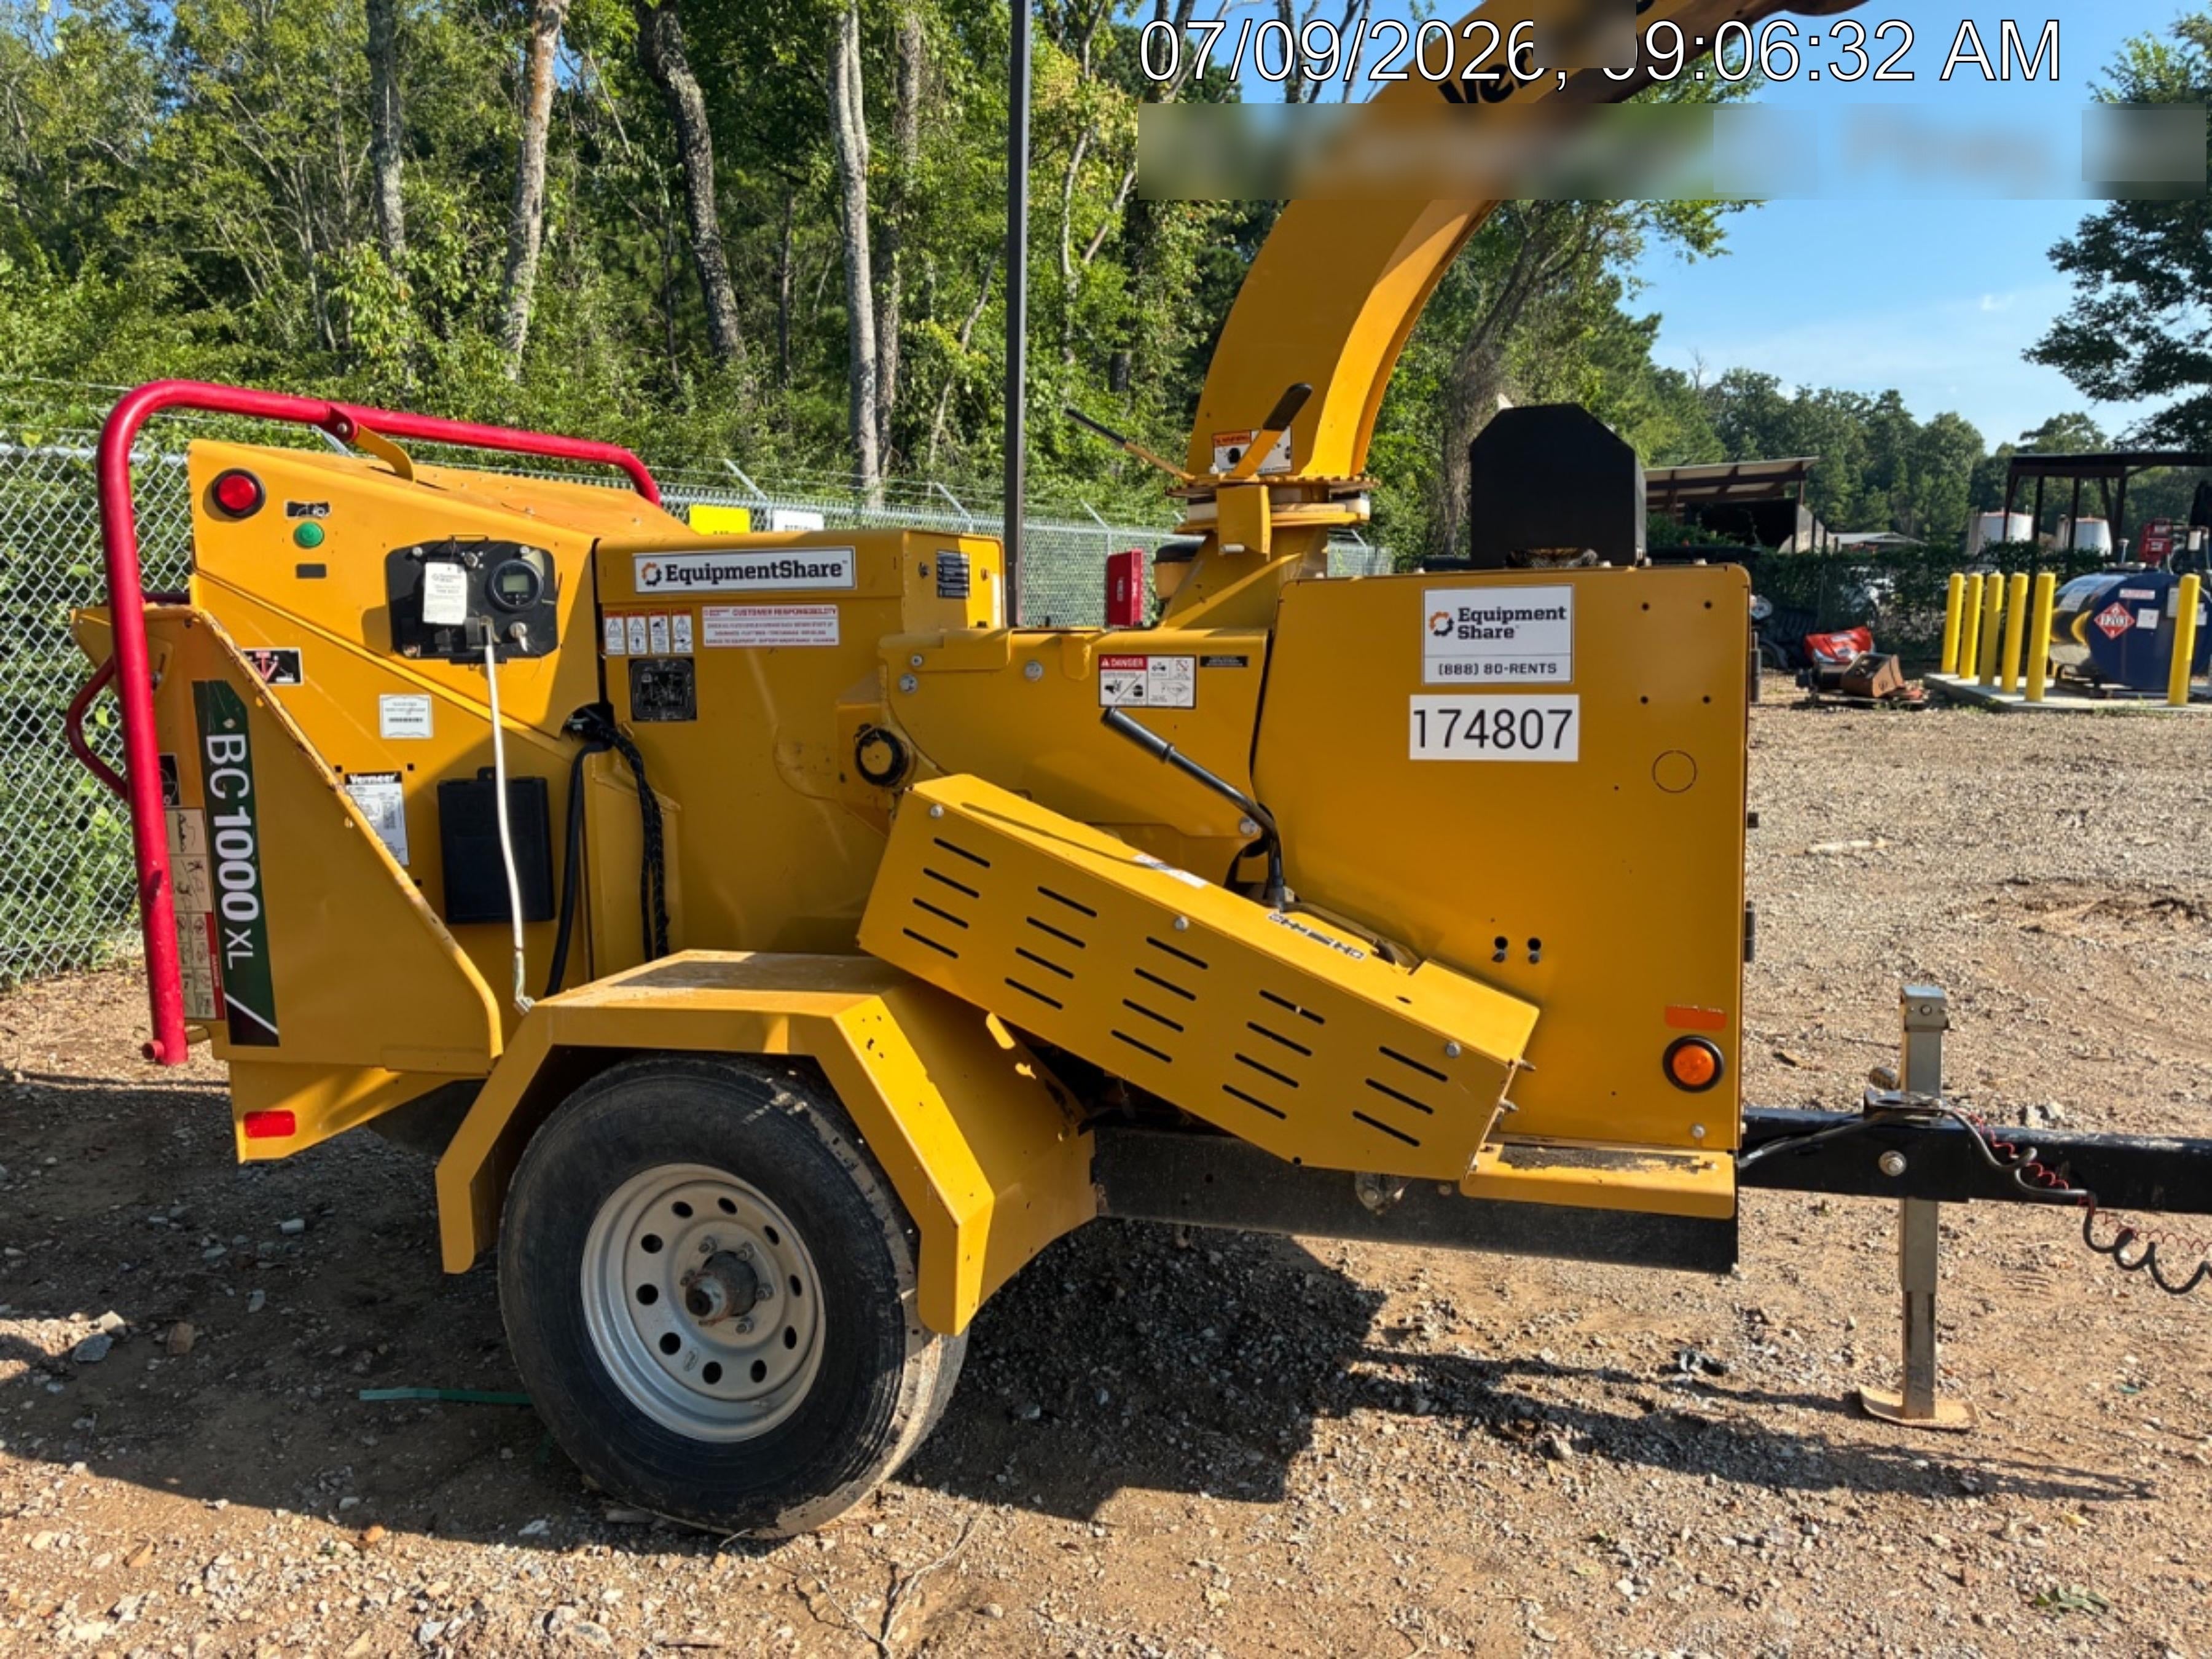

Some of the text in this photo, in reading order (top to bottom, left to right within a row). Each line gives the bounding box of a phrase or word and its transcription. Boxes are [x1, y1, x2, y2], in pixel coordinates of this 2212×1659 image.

[665, 560, 842, 585] EquipmentShare
[1457, 606, 1567, 625] Equipment
[1457, 625, 1515, 640] Share
[1110, 657, 1144, 668] DANGER
[1438, 662, 1557, 675] (888) 80-RENTS
[1413, 708, 1573, 750] 174807
[224, 928, 254, 970] XL
